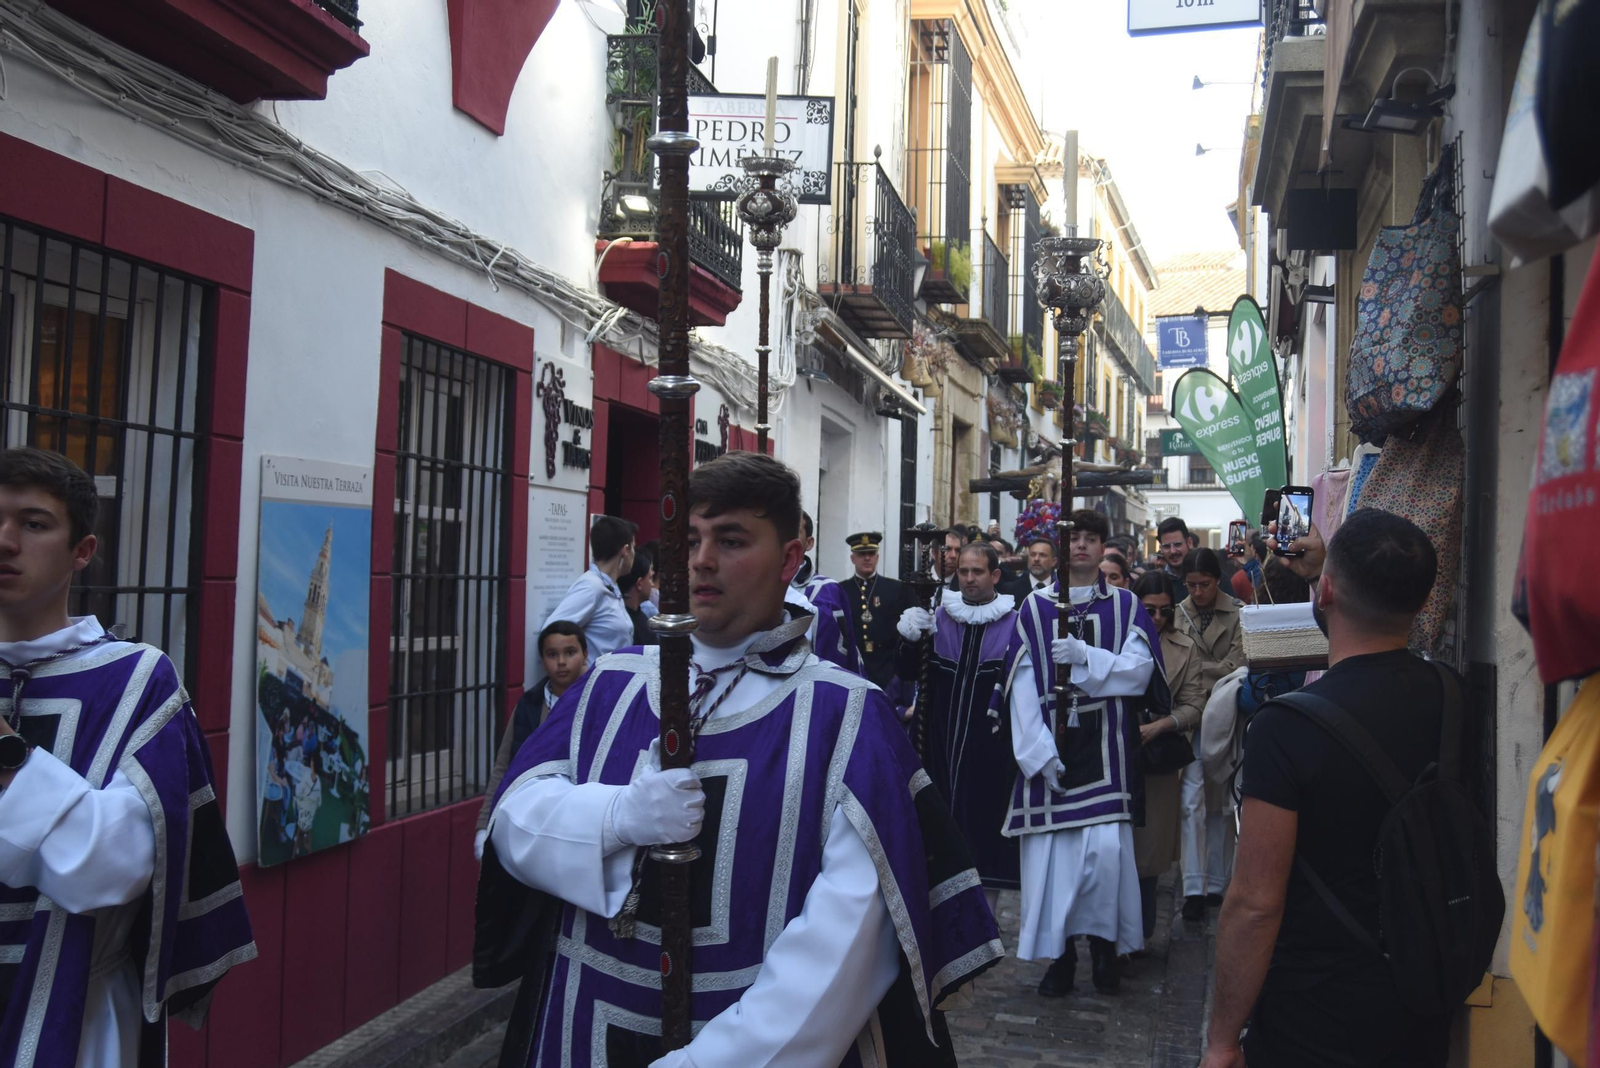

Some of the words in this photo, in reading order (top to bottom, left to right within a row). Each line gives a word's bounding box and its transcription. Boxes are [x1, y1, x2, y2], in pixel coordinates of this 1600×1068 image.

[695, 119, 791, 143] PEDRO
[563, 398, 595, 430] VINOS
[1195, 415, 1240, 439] express
[1222, 452, 1259, 473] NUEVO
[274, 471, 299, 487] VISITA
[301, 474, 333, 491] NUESTRA
[335, 477, 363, 493] TERRAZA
[1226, 465, 1262, 486] SUPER
